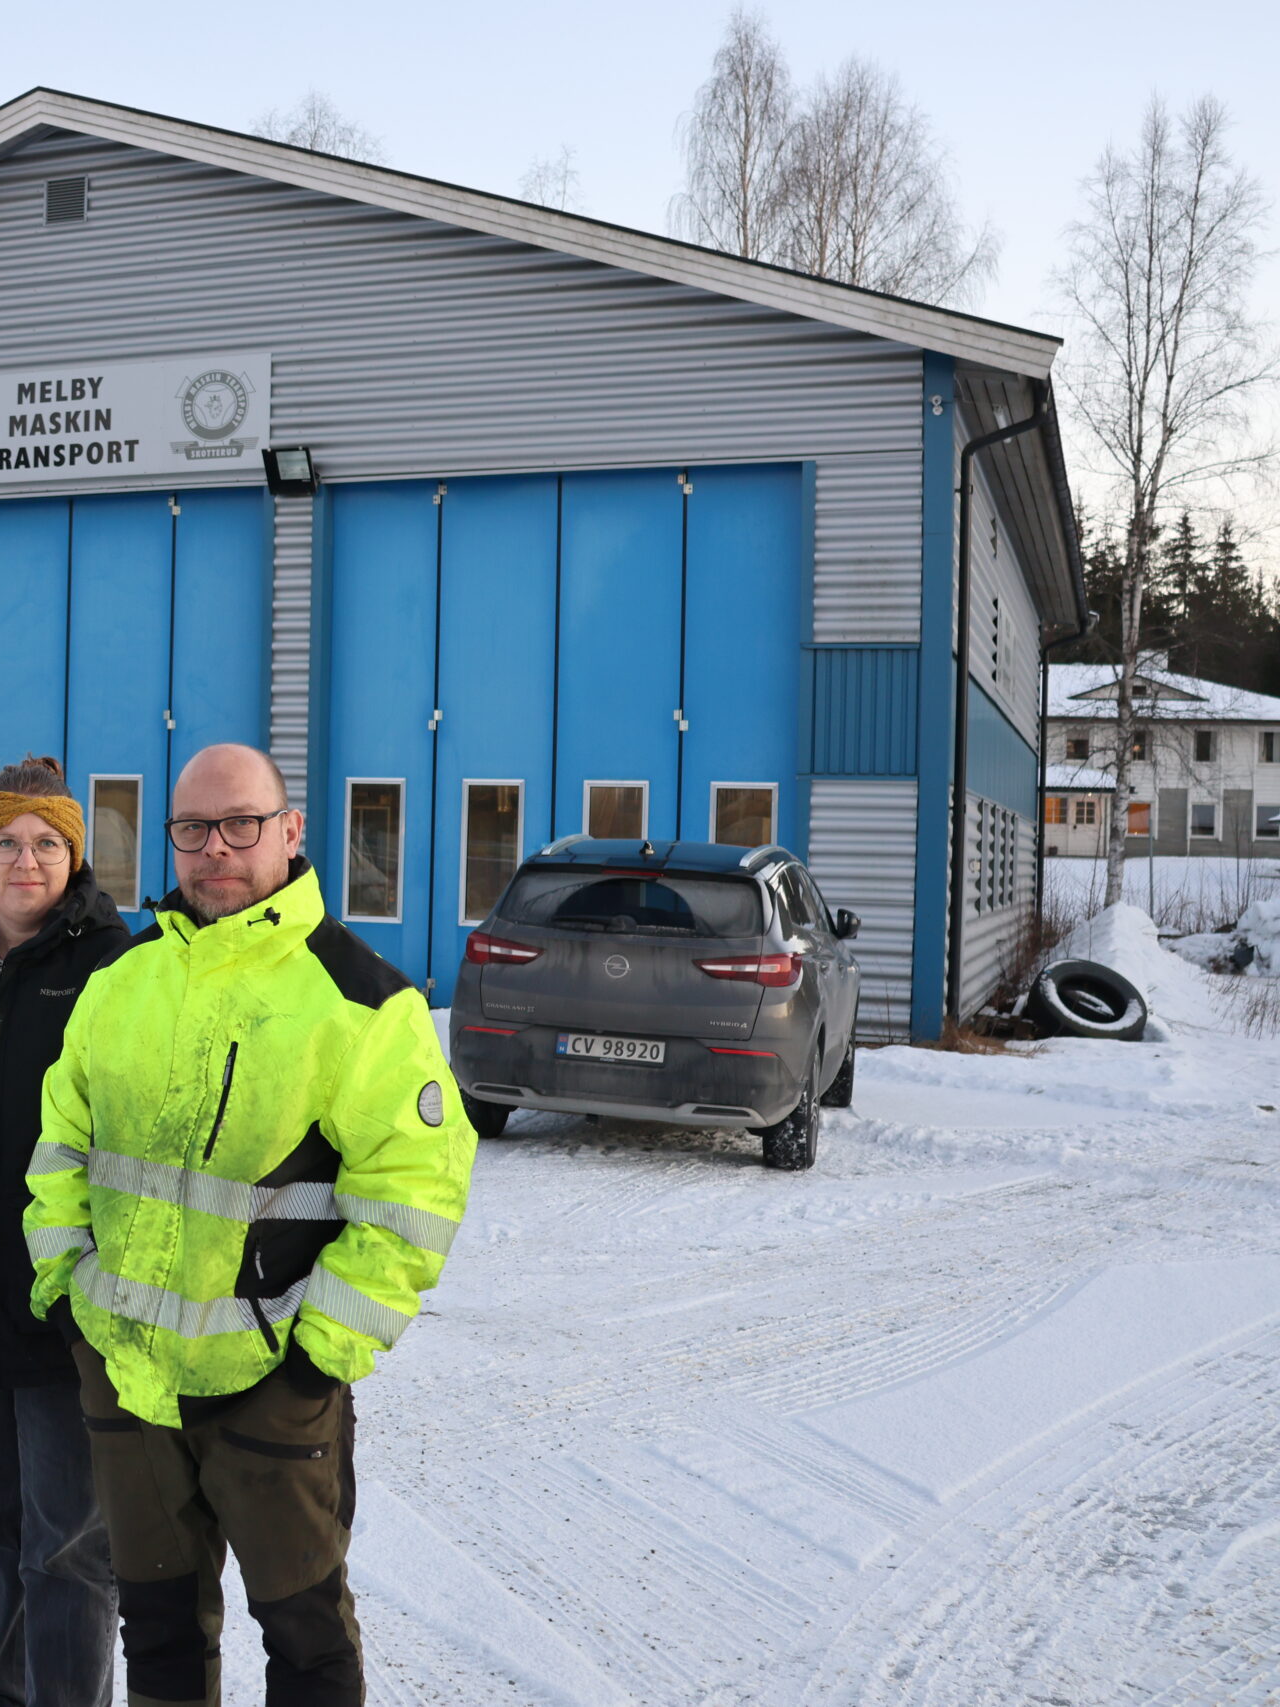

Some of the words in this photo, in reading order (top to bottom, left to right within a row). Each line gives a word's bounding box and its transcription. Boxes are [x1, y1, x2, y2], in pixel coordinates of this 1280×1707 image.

[17, 376, 104, 405] MELBY
[189, 372, 222, 395] MASKIN
[225, 375, 246, 427] TRANSPORT
[9, 408, 111, 437] MASKIN
[190, 447, 238, 458] SKOTTERUD
[40, 988, 76, 997] NEWPORT
[571, 1037, 595, 1054] CV
[602, 1039, 660, 1060] 98920
